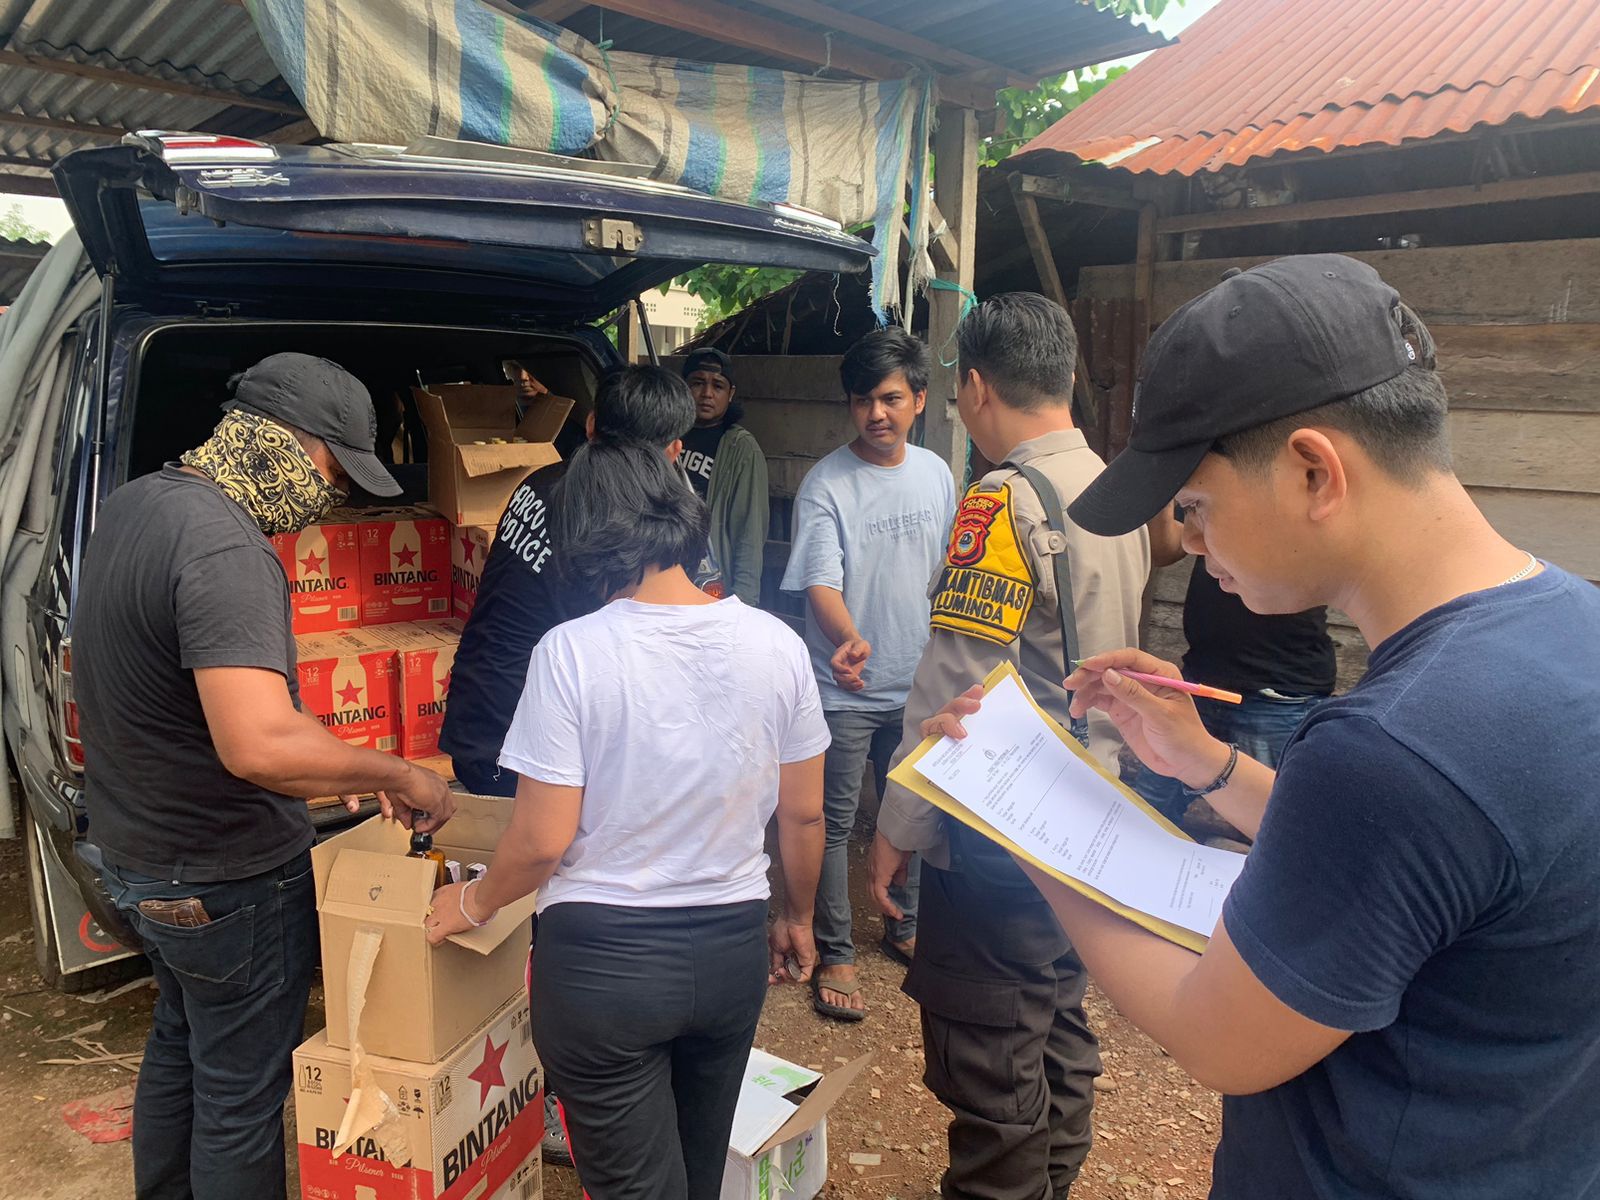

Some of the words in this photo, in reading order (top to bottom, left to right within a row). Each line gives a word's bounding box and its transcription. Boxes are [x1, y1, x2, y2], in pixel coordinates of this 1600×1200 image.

[680, 449, 714, 480] IGE
[509, 484, 550, 544] ARCO
[367, 528, 379, 538] 12
[500, 510, 552, 574] POLICE
[290, 576, 347, 594] INTANG
[374, 569, 438, 586] BINTANG
[409, 656, 421, 667] 12
[305, 666, 320, 678] 12
[417, 699, 447, 717] BIN
[305, 1064, 323, 1082] 12
[438, 1075, 451, 1095] 12
[443, 1067, 539, 1191] BINTANG
[345, 1157, 385, 1178] Pilsener
